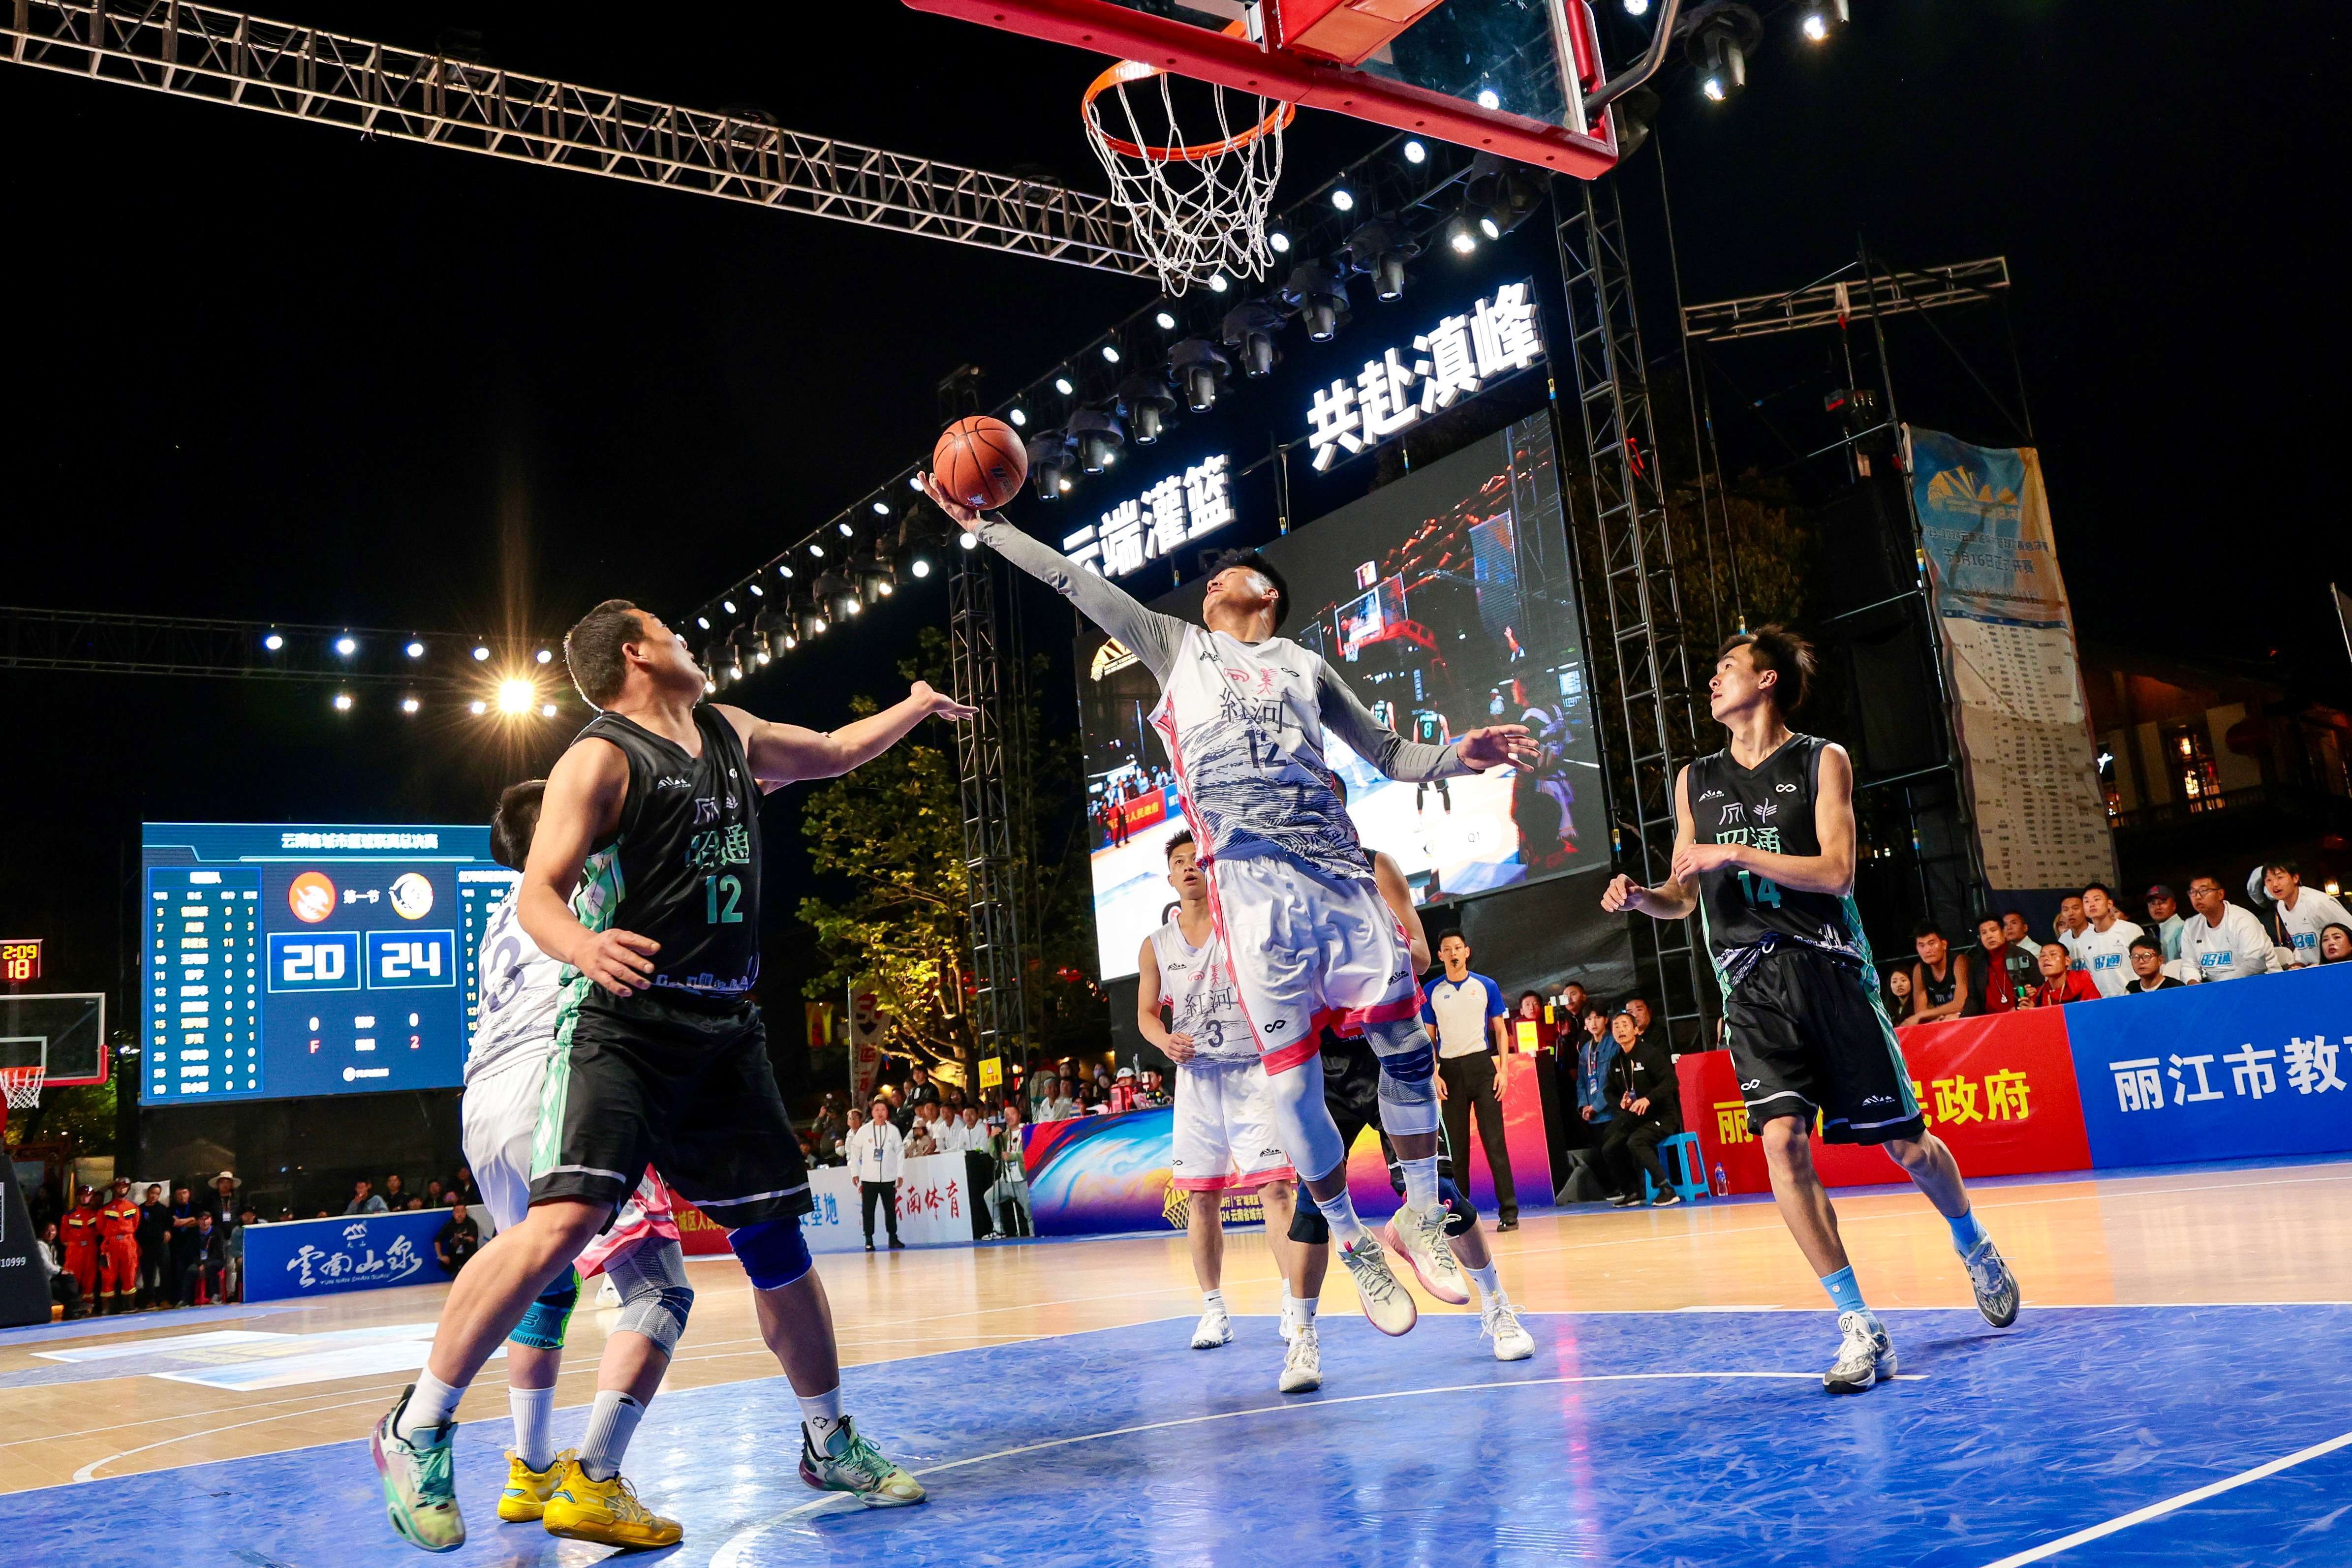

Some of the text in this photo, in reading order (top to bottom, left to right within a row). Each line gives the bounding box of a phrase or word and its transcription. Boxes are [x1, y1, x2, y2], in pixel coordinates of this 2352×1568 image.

[1307, 283, 1544, 471] 共赴滇峰
[1063, 454, 1237, 578] 云端灌篮
[1424, 721, 1433, 738] 8
[1244, 729, 1288, 768] 12
[343, 890, 380, 904] 第一节
[1737, 870, 1781, 911] 14
[705, 874, 743, 923] 12
[157, 908, 163, 916] 5
[225, 907, 232, 915] 9
[157, 922, 254, 932] 7 0 3
[156, 938, 253, 948] 8 11 1
[2, 945, 37, 959] 2:09
[225, 954, 232, 962] 0
[247, 953, 254, 962] 0
[283, 945, 344, 981] 20
[382, 942, 441, 978] 24
[2200, 952, 2232, 967] 昭通
[8, 959, 30, 979] 18
[155, 969, 254, 980] 11 0 0
[468, 978, 474, 986] 9
[155, 984, 254, 996] 12 0 0
[155, 1000, 255, 1012] 14 0 0
[155, 1020, 166, 1028] 15
[225, 1017, 232, 1026] 0
[309, 1017, 319, 1031] 0
[409, 1013, 418, 1027] 0
[225, 1033, 232, 1042] 0
[1206, 1020, 1224, 1047] 3
[310, 1040, 319, 1053] F
[410, 1036, 419, 1048] 2
[225, 1049, 233, 1058] 0
[248, 1048, 255, 1057] 0
[225, 1065, 233, 1074] 0
[248, 1064, 255, 1073] 0
[2109, 1035, 2352, 1112] 丽江市教
[226, 1081, 233, 1090] 0
[248, 1079, 255, 1089] 0
